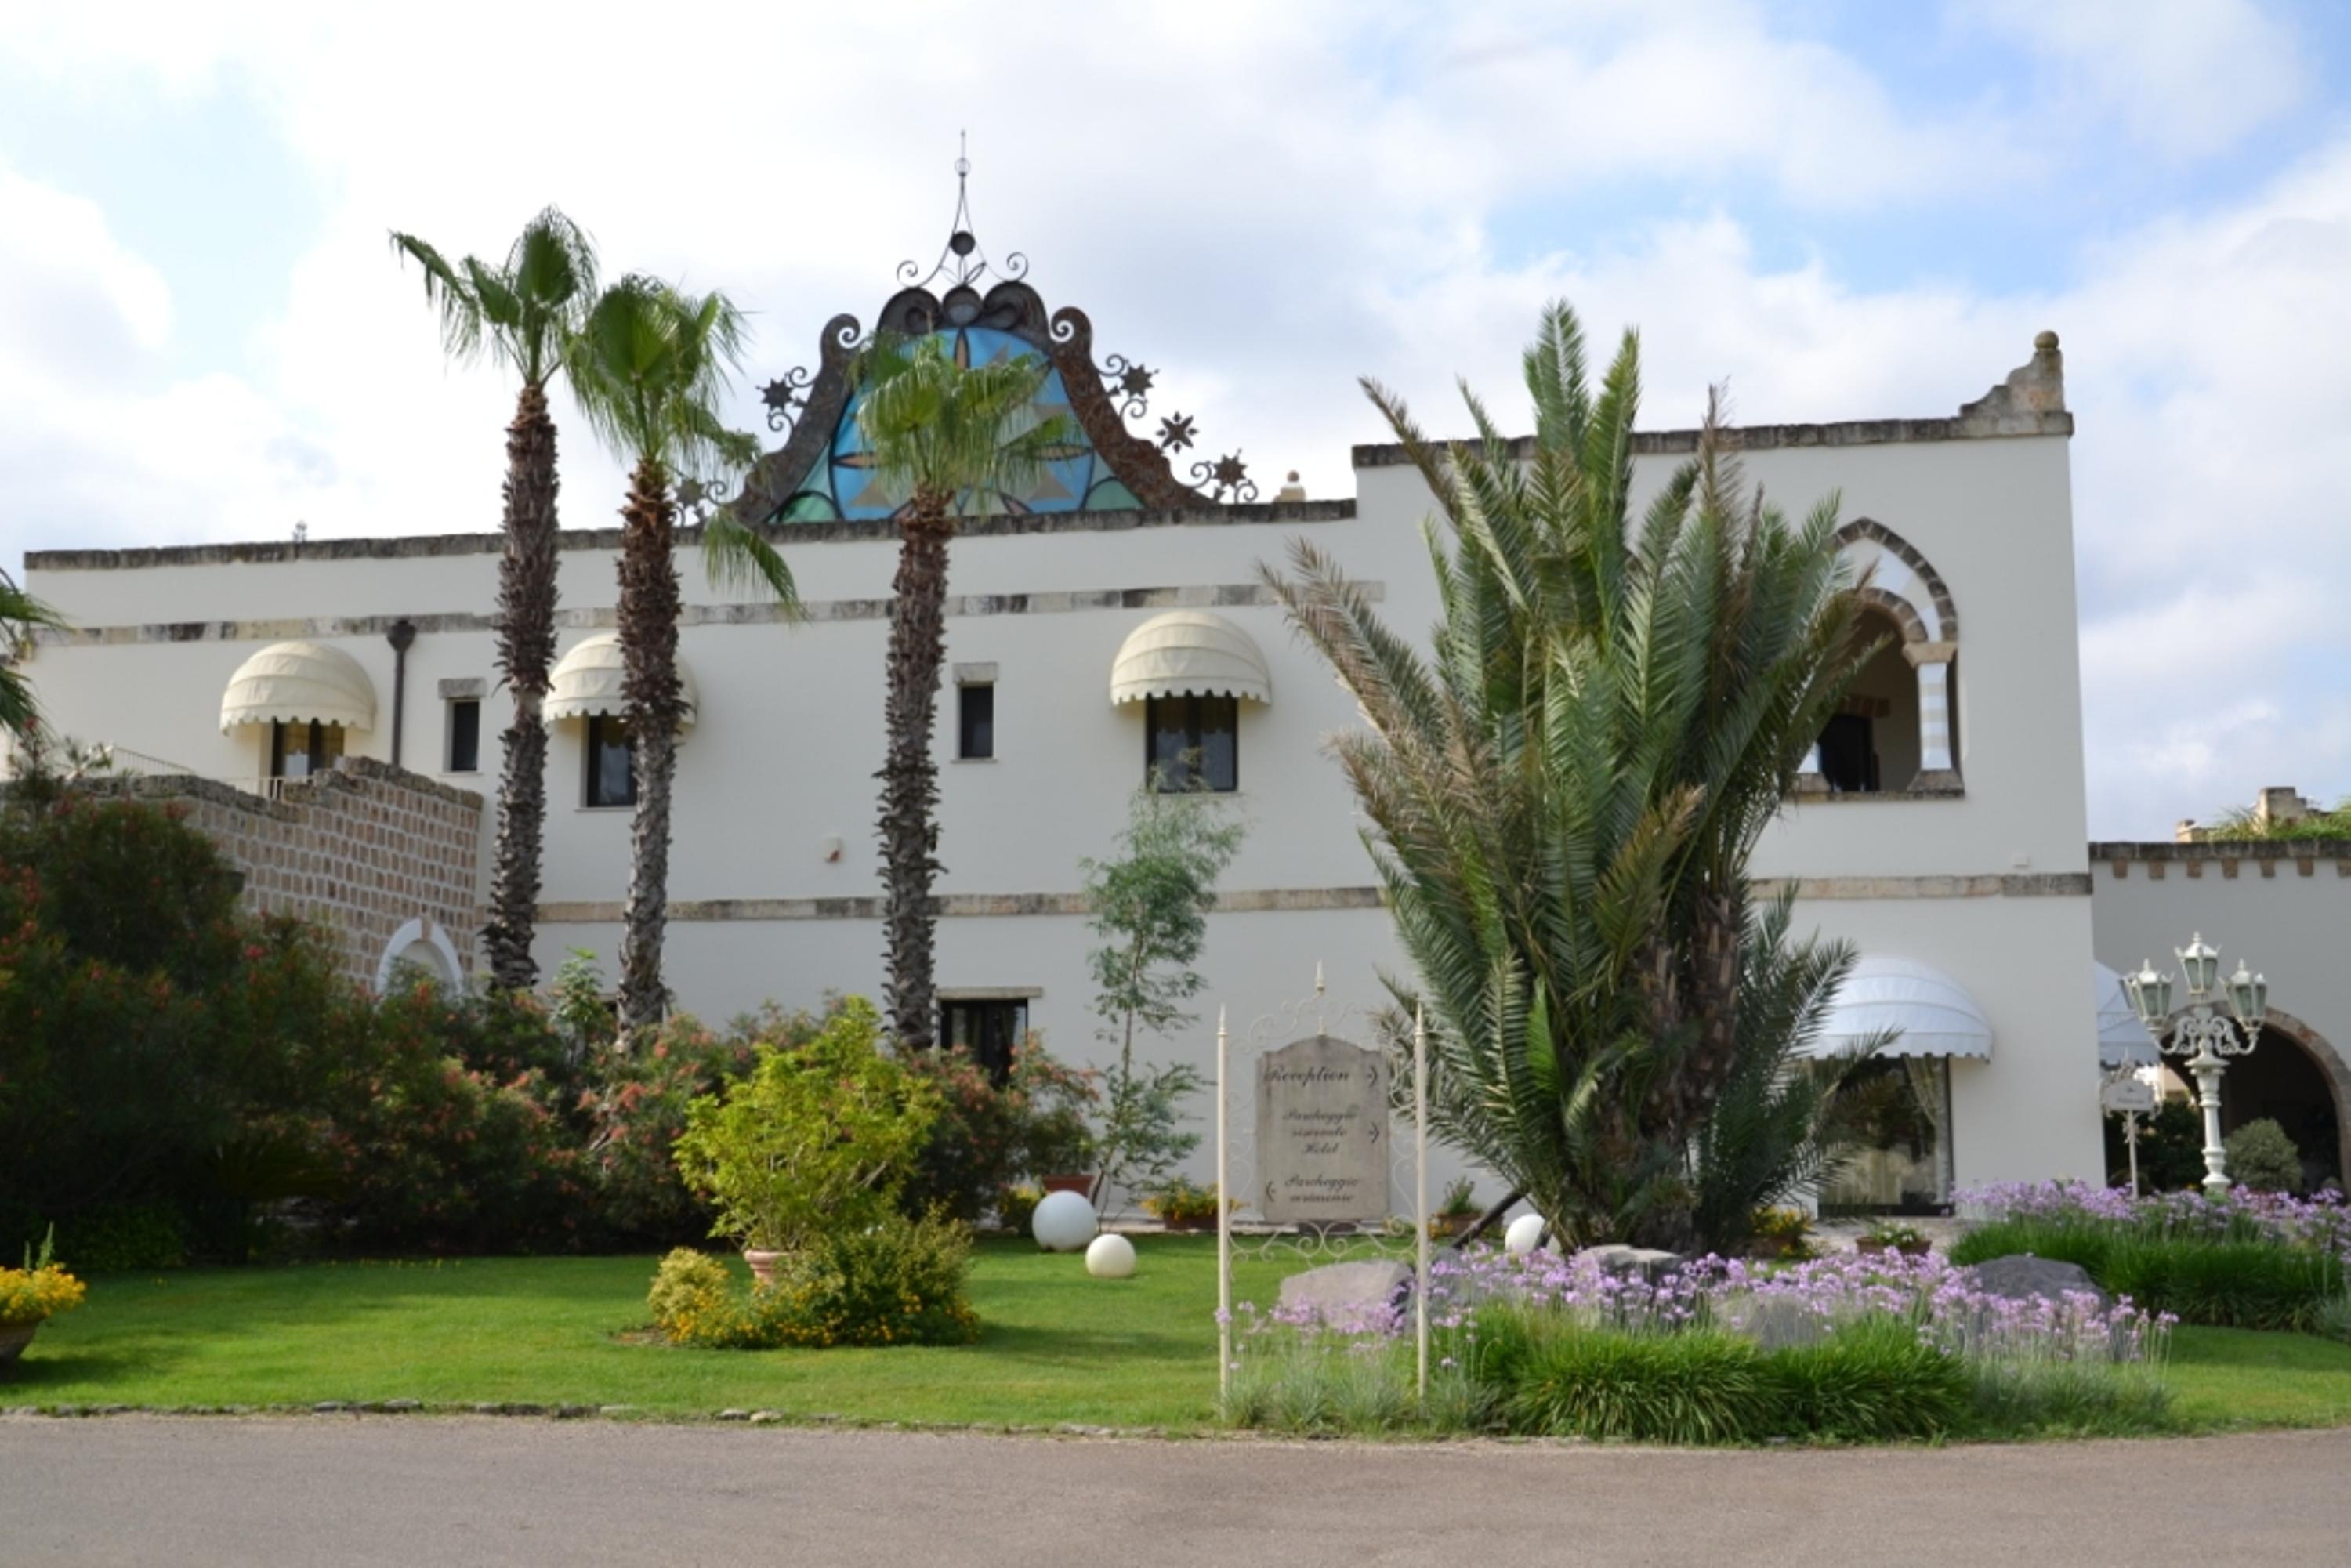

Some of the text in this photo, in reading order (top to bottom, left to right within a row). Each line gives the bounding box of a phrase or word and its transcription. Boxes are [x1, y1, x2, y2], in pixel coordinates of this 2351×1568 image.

[1264, 1064, 1349, 1087] Reception
[1301, 1143, 1339, 1154] Hotel
[1284, 1174, 1360, 1192] Parcheggio
